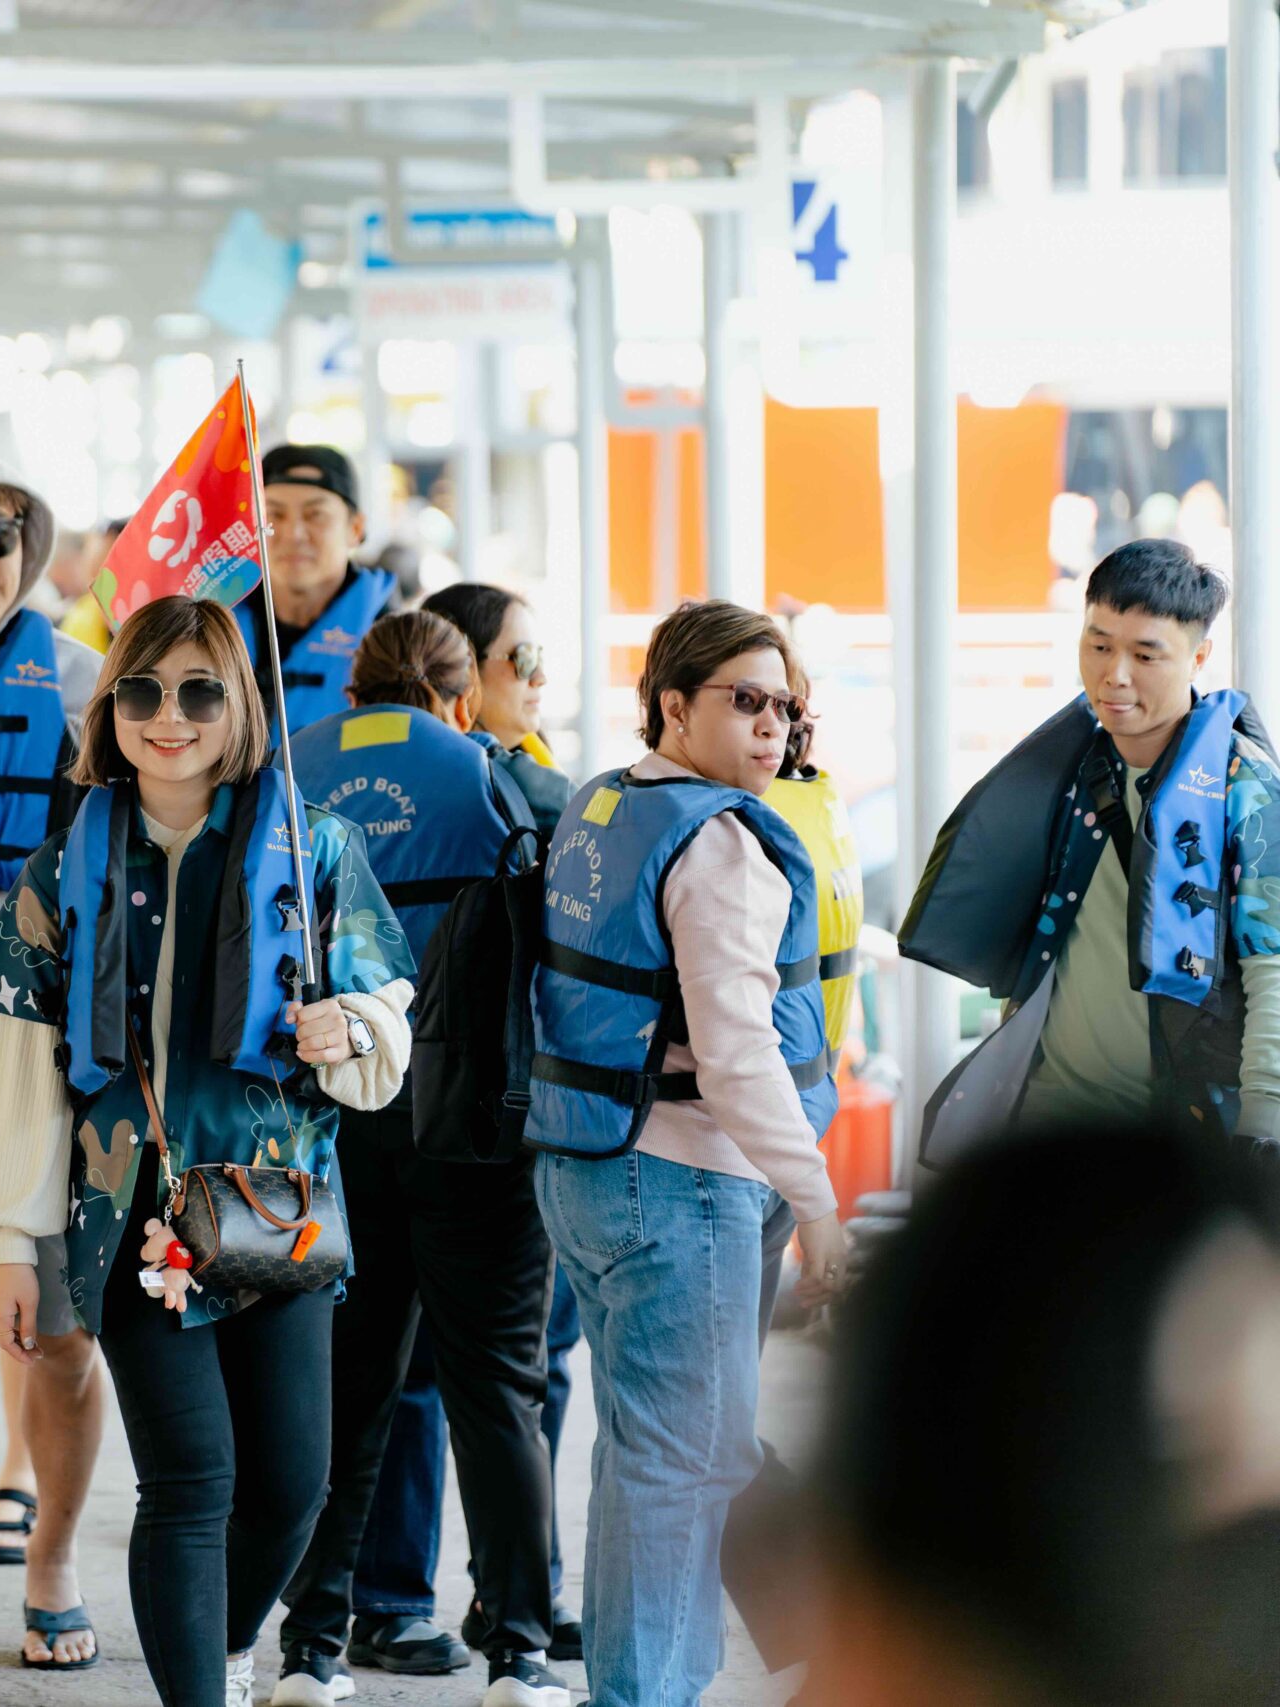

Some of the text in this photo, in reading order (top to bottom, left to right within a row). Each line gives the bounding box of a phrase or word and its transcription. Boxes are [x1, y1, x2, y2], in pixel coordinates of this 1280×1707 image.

[321, 777, 417, 815] PEED BOAT
[586, 838, 602, 903] BOAT
